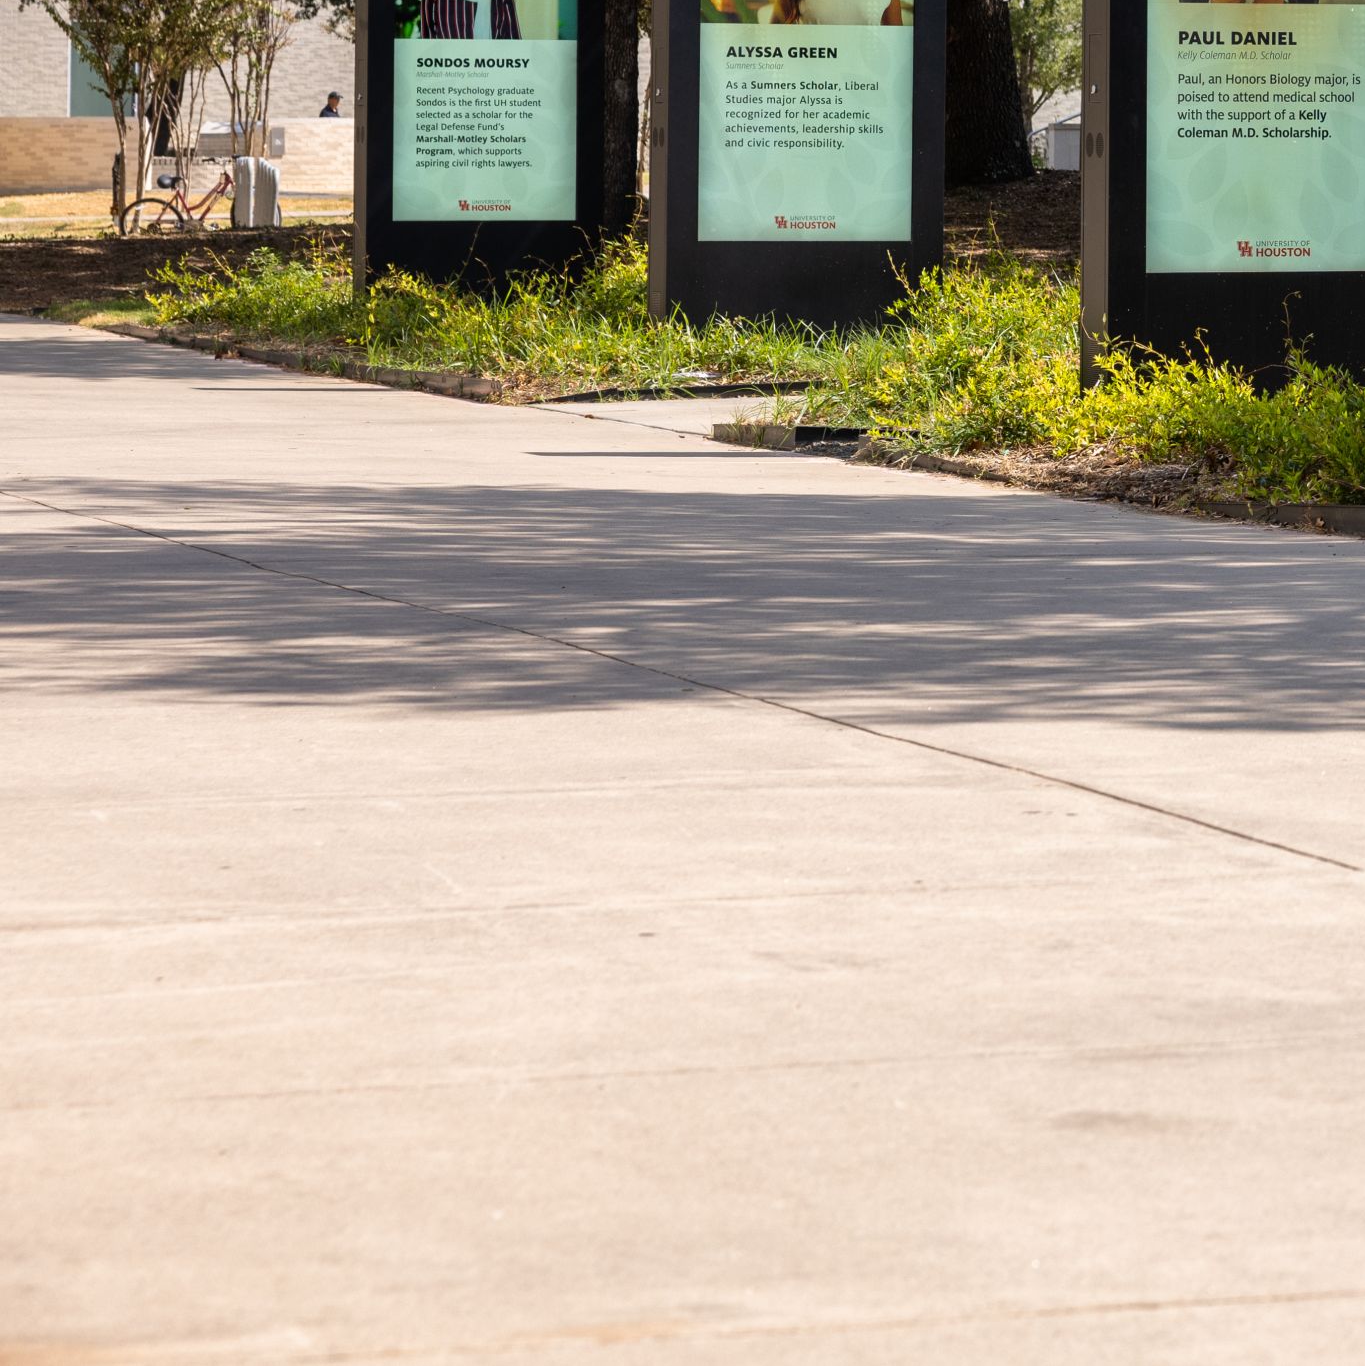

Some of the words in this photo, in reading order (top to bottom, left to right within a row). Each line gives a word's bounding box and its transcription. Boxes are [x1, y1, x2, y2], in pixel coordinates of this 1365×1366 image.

[1179, 31, 1225, 45] PAUL
[1231, 31, 1297, 45] DANIEL
[726, 46, 783, 58] ALYSSA
[787, 47, 837, 59] GREEN
[1178, 50, 1198, 61] Kelly
[1199, 50, 1236, 60] Coleman
[1238, 51, 1258, 60] M.D.
[1260, 50, 1291, 60] Scholar
[417, 57, 470, 68] SONDOS
[474, 58, 530, 68] MOURSY
[726, 80, 738, 89] As
[751, 80, 796, 90] Sumners
[800, 80, 841, 91] Scholar,
[845, 81, 879, 91] Liberal
[1178, 73, 1205, 86] Paul,
[1208, 75, 1222, 85] an
[1226, 74, 1267, 85] Honors
[1270, 73, 1311, 87] Biology
[1314, 73, 1349, 88] major,
[1352, 73, 1361, 85] is
[416, 86, 445, 95] Recent
[448, 86, 495, 96] Psychology
[497, 87, 535, 96] graduate
[416, 98, 447, 107] Sondos
[449, 98, 456, 106] is
[458, 99, 473, 107] the
[474, 98, 491, 107] first
[494, 99, 507, 107] UH
[509, 99, 541, 107] student
[725, 94, 763, 104] Studies
[766, 95, 797, 107] major
[799, 95, 832, 107] Alyssa
[835, 95, 843, 105] is
[1177, 91, 1215, 104] poised
[1218, 92, 1230, 102] to
[1232, 91, 1269, 103] attend
[1273, 91, 1316, 103] medical
[1319, 91, 1355, 103] school
[416, 110, 451, 119] selected
[472, 111, 502, 119] scholar
[504, 110, 517, 119] for
[519, 111, 533, 119] the
[725, 109, 781, 121] recognized
[785, 109, 800, 119] for
[802, 109, 820, 119] her
[822, 109, 870, 120] academic
[1177, 109, 1202, 120] with
[1205, 109, 1225, 120] the
[1227, 110, 1271, 123] support
[1274, 109, 1286, 120] of
[1289, 112, 1296, 120] a
[1299, 109, 1327, 123] Kelly
[416, 123, 438, 133] Legal
[441, 123, 475, 131] Defense
[477, 123, 505, 131] Fund's
[725, 123, 799, 135] achievements,
[802, 124, 855, 135] leadership
[858, 124, 885, 134] skills
[1177, 127, 1228, 138] Coleman
[1232, 127, 1259, 138] M.D.
[1262, 126, 1332, 141] Scholarship.
[416, 135, 488, 145] Marshall-Motley
[490, 135, 526, 143] Scholars
[724, 138, 744, 148] and
[747, 138, 770, 148] civic
[773, 138, 845, 150] responsibility.
[416, 147, 455, 157] Program,
[458, 147, 483, 155] which
[485, 148, 522, 157] supports
[415, 159, 450, 169] aspiring
[452, 159, 469, 167] civil
[471, 159, 496, 169] rights
[498, 159, 532, 169] lawyers.
[471, 204, 511, 212] HOUSTON
[790, 221, 836, 229] HOUSTON
[1256, 247, 1311, 257] HOUSTON
